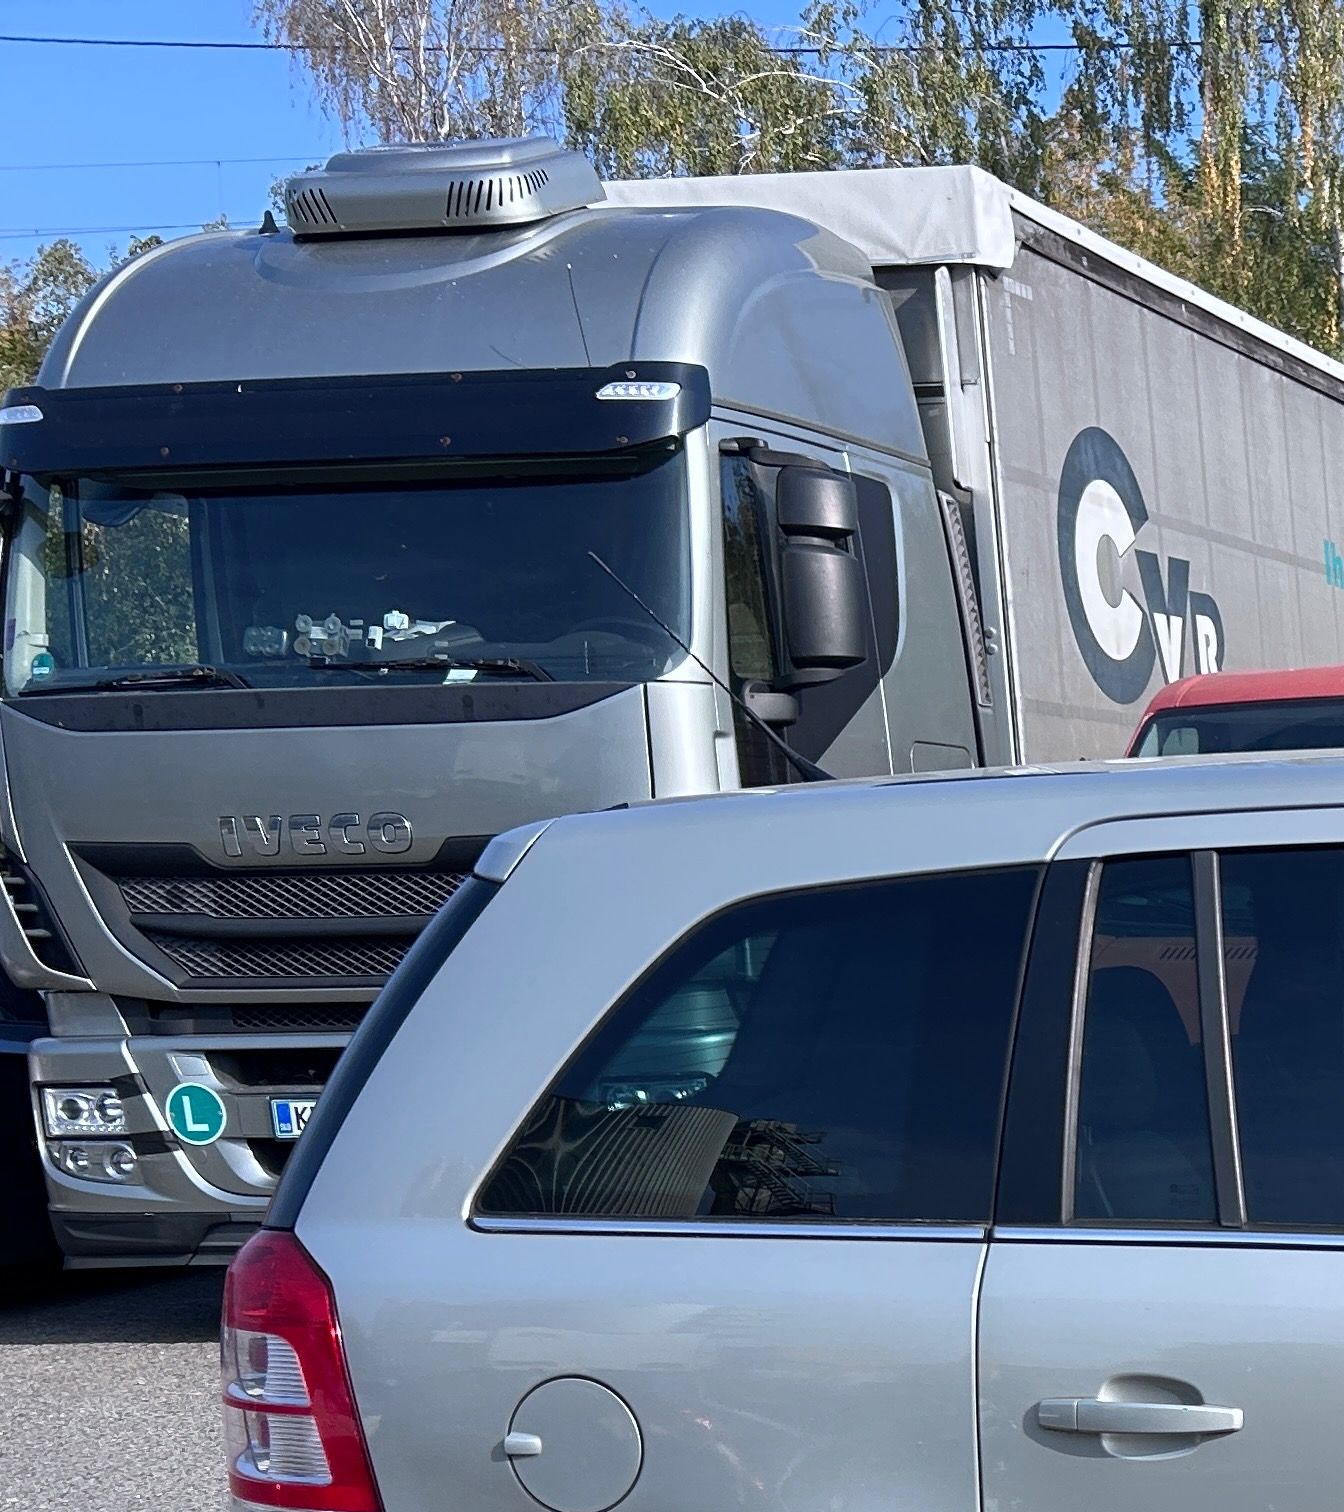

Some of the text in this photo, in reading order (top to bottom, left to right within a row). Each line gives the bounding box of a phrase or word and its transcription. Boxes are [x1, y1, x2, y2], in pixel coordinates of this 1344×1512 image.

[218, 811, 414, 857] IVECO
[182, 1096, 210, 1131] L
[294, 1106, 316, 1131] K
